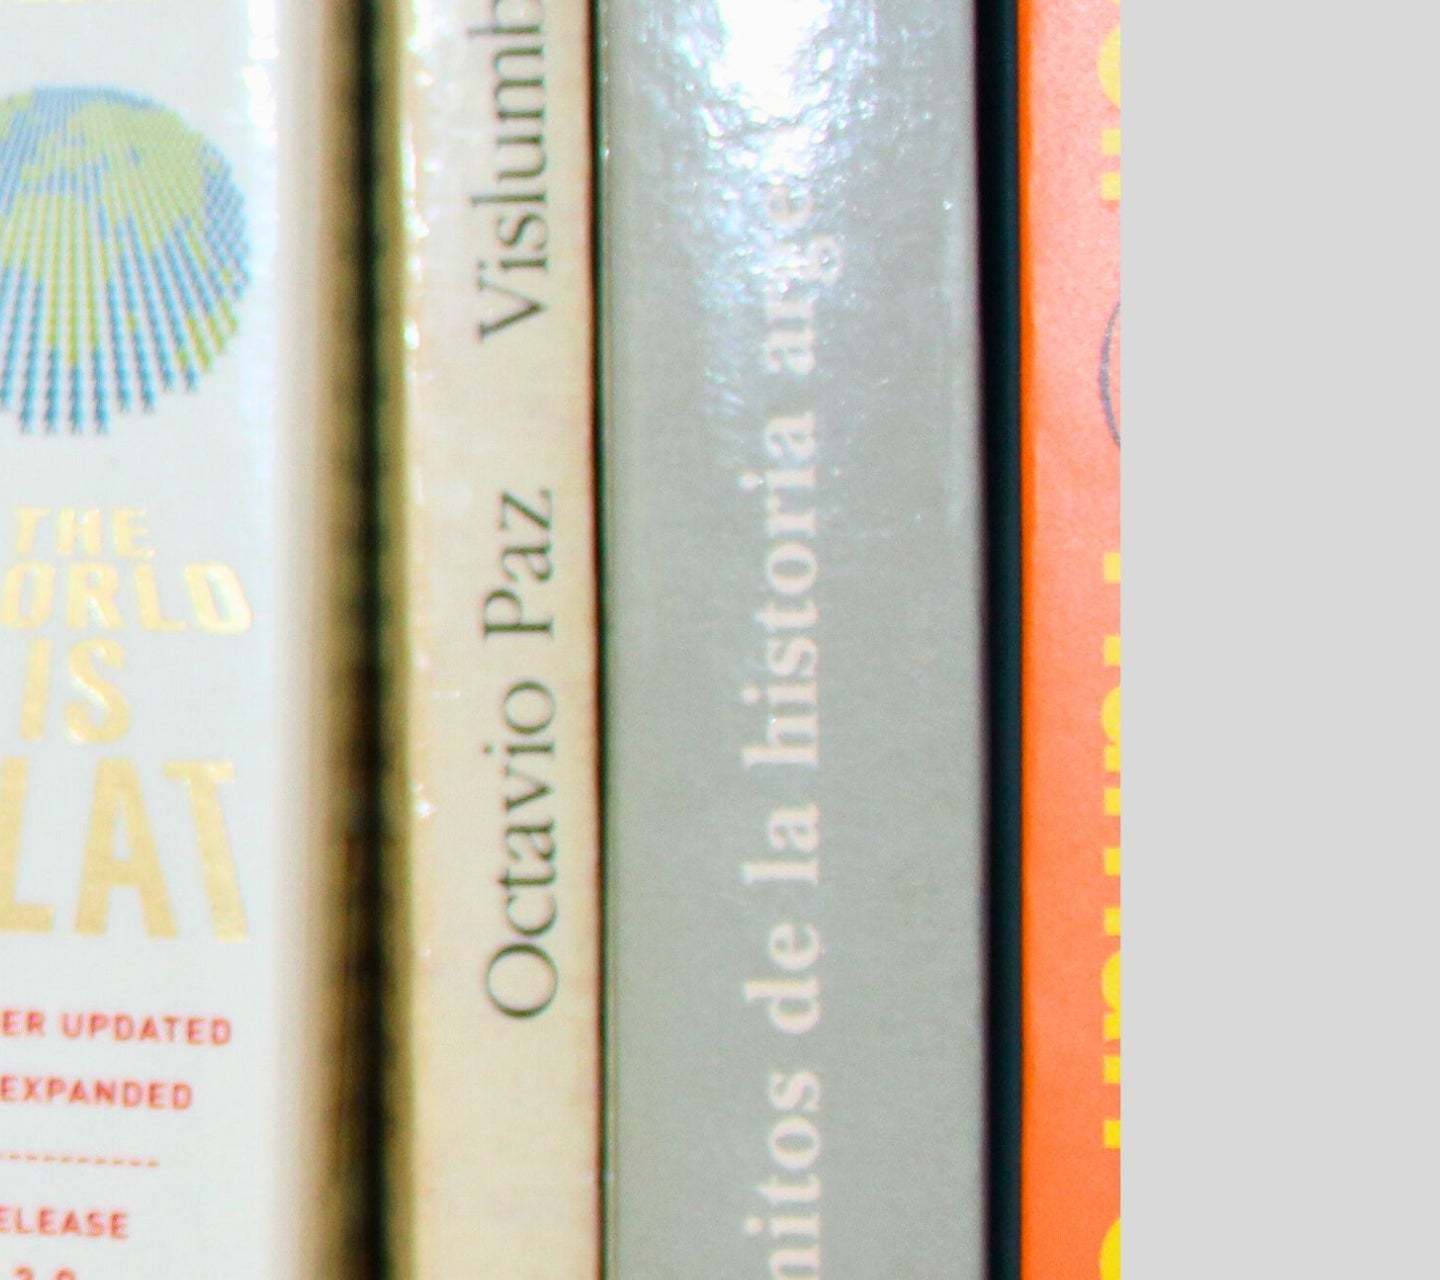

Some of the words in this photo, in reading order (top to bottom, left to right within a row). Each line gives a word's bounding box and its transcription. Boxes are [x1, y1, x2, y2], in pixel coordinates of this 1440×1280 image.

[15, 506, 154, 558] THE
[483, 489, 553, 640] Paz
[739, 410, 819, 769] historia
[20, 636, 130, 745] IS
[485, 678, 558, 1020] Octavio
[743, 802, 819, 886] la
[61, 1013, 232, 1046] UPDATED
[744, 923, 822, 1034] de
